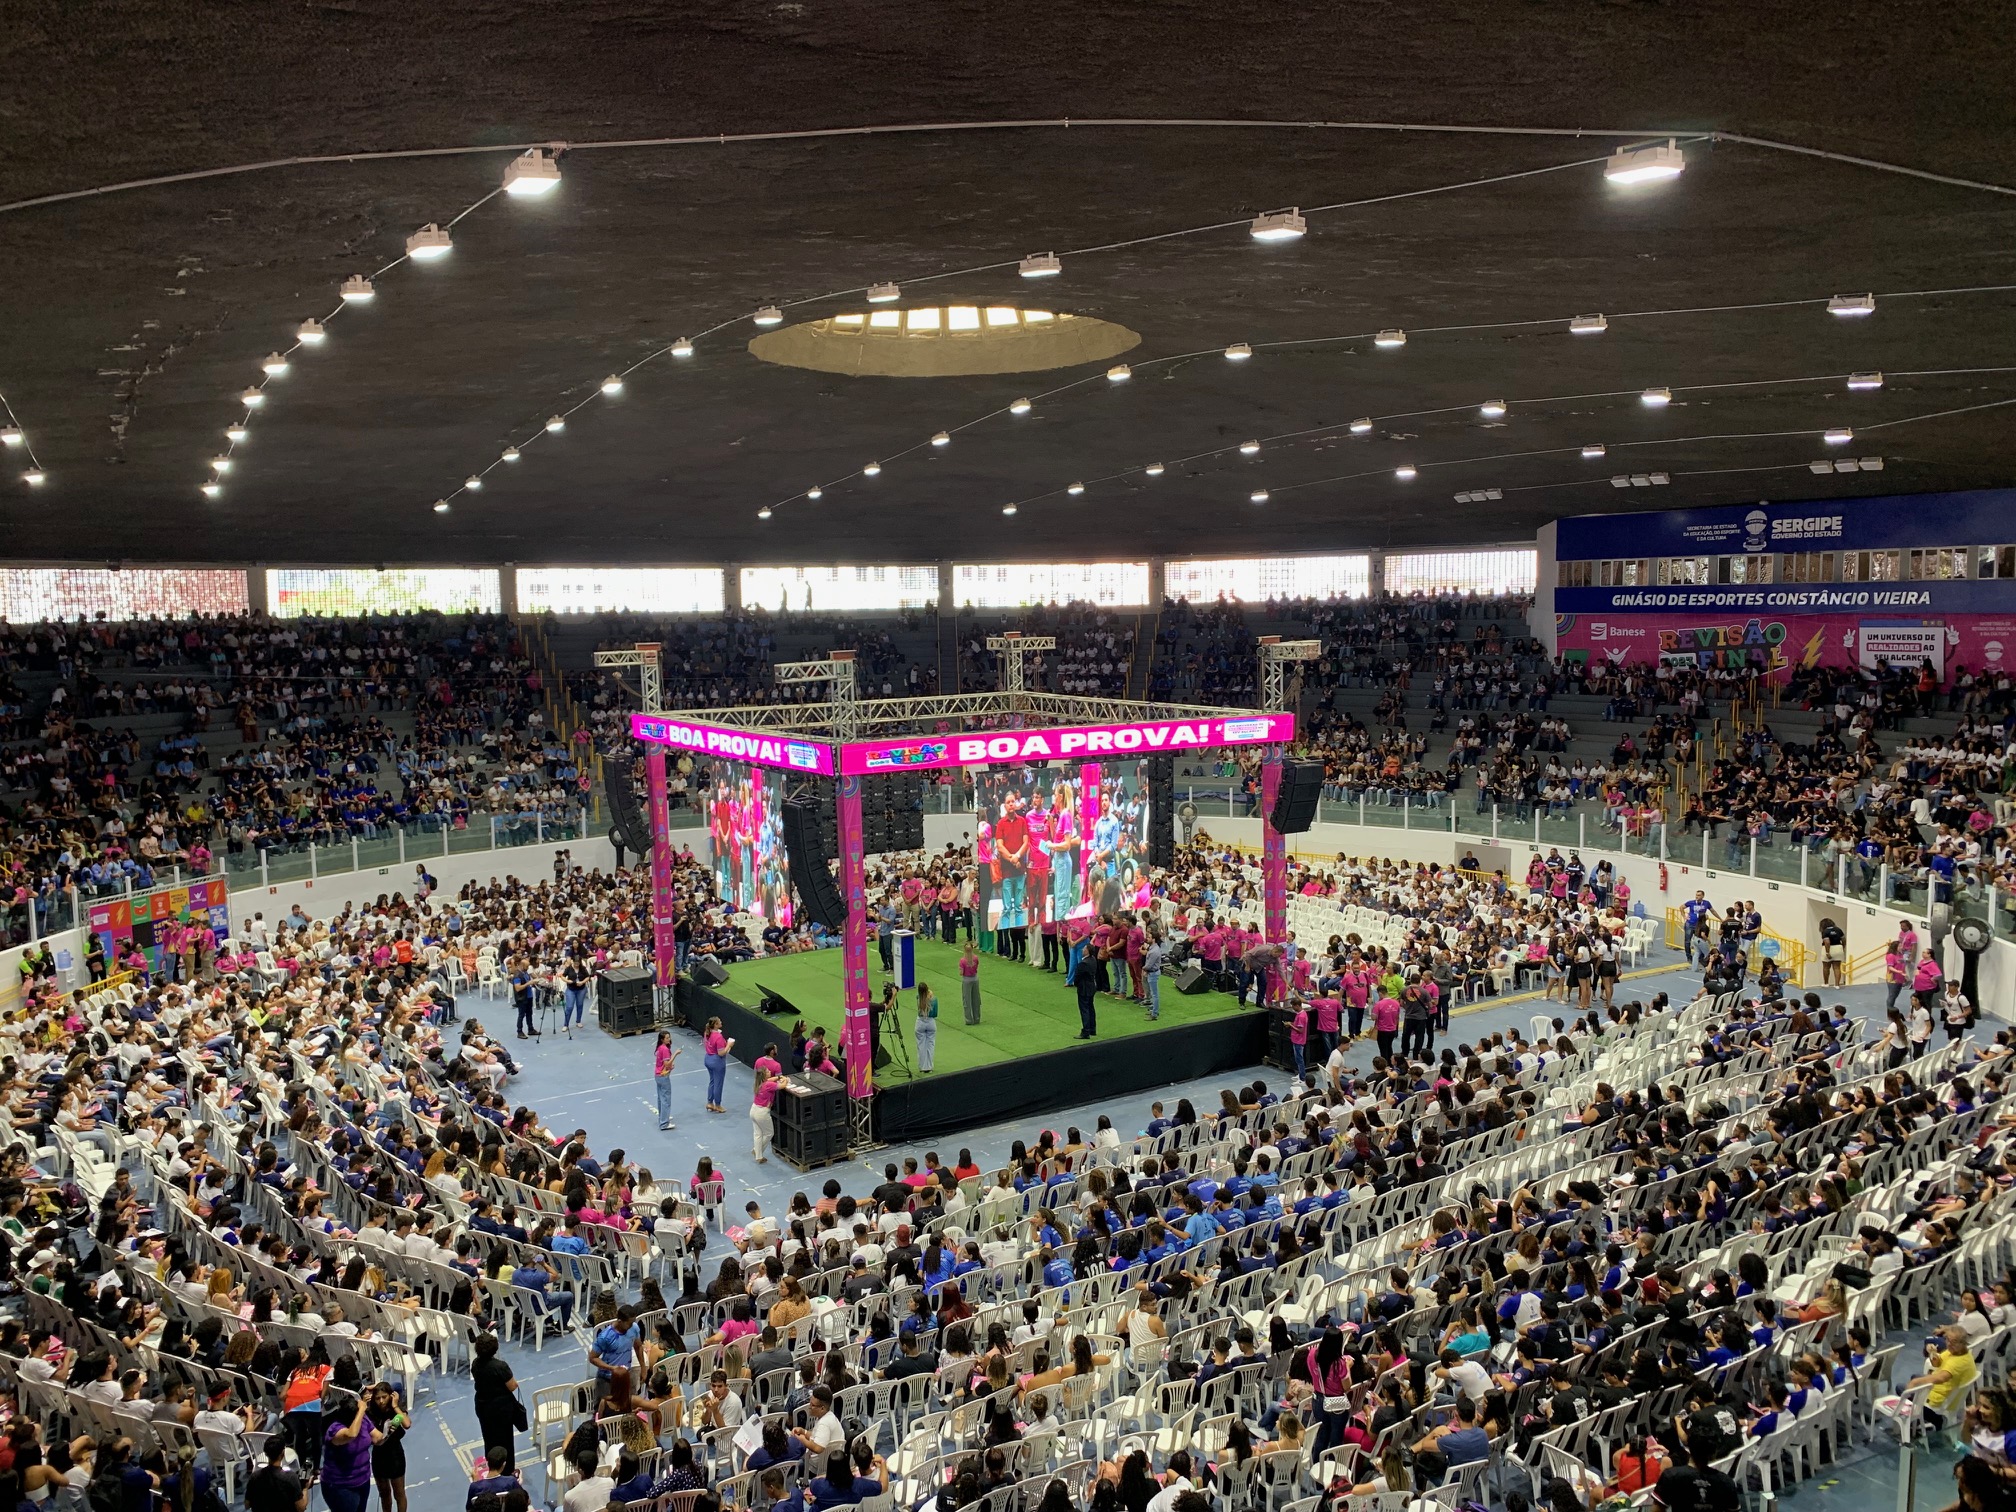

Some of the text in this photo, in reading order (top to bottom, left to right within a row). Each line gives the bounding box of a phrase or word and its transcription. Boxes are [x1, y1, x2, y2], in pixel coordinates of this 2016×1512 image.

[1772, 516, 1843, 533] SERGIPE
[1771, 532, 1803, 540] GOVERNO
[1815, 530, 1842, 538] ESTADO
[1612, 589, 1931, 606] GINÁSIO DE ESPORTES CONSTÂNCIO VIEIRA
[1610, 626, 1646, 637] Banese
[1660, 619, 1786, 649] REVISÃO
[1868, 643, 1920, 651] REALIDADES
[669, 725, 705, 748] BOA
[707, 732, 782, 762] PROVA!
[959, 736, 1051, 761] BOA
[1061, 724, 1209, 752] PROVA!
